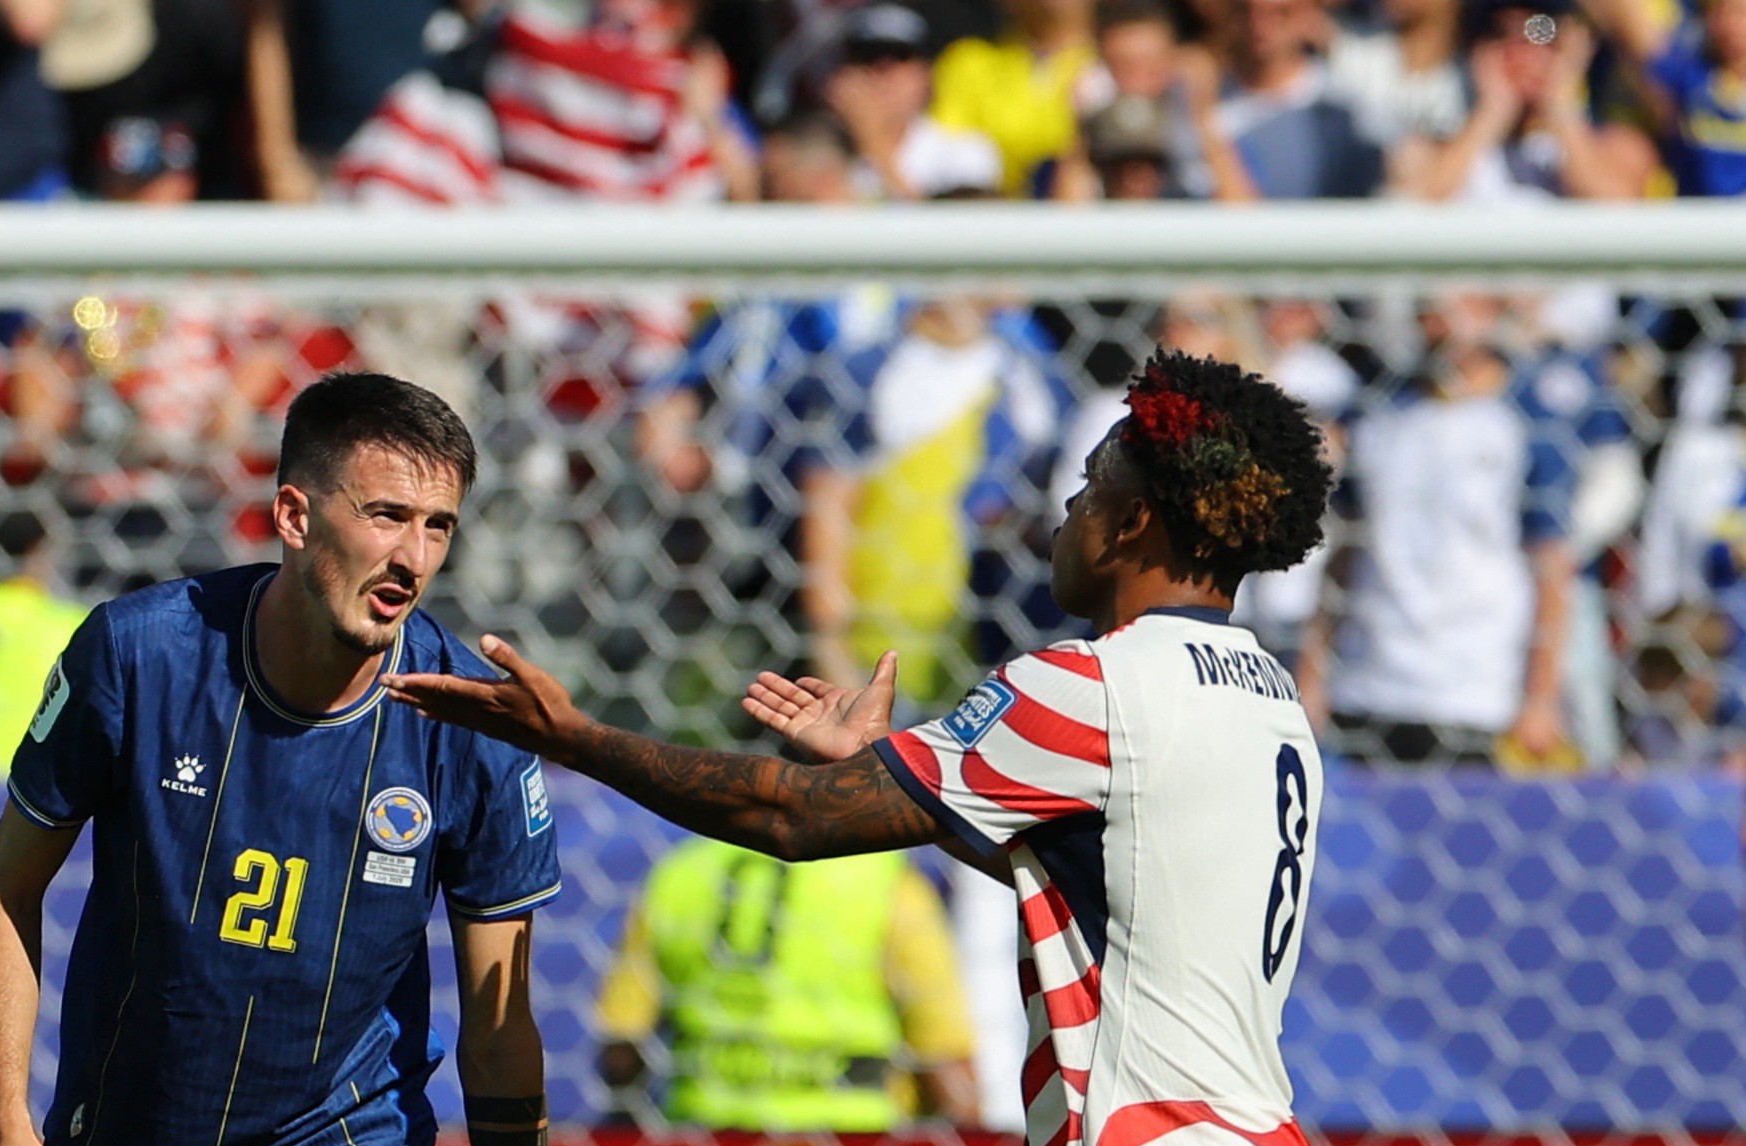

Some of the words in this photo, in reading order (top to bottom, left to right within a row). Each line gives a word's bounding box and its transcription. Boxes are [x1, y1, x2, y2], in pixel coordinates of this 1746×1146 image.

[161, 778, 208, 797] KELME
[219, 848, 309, 954] 21
[1262, 743, 1308, 985] 8
